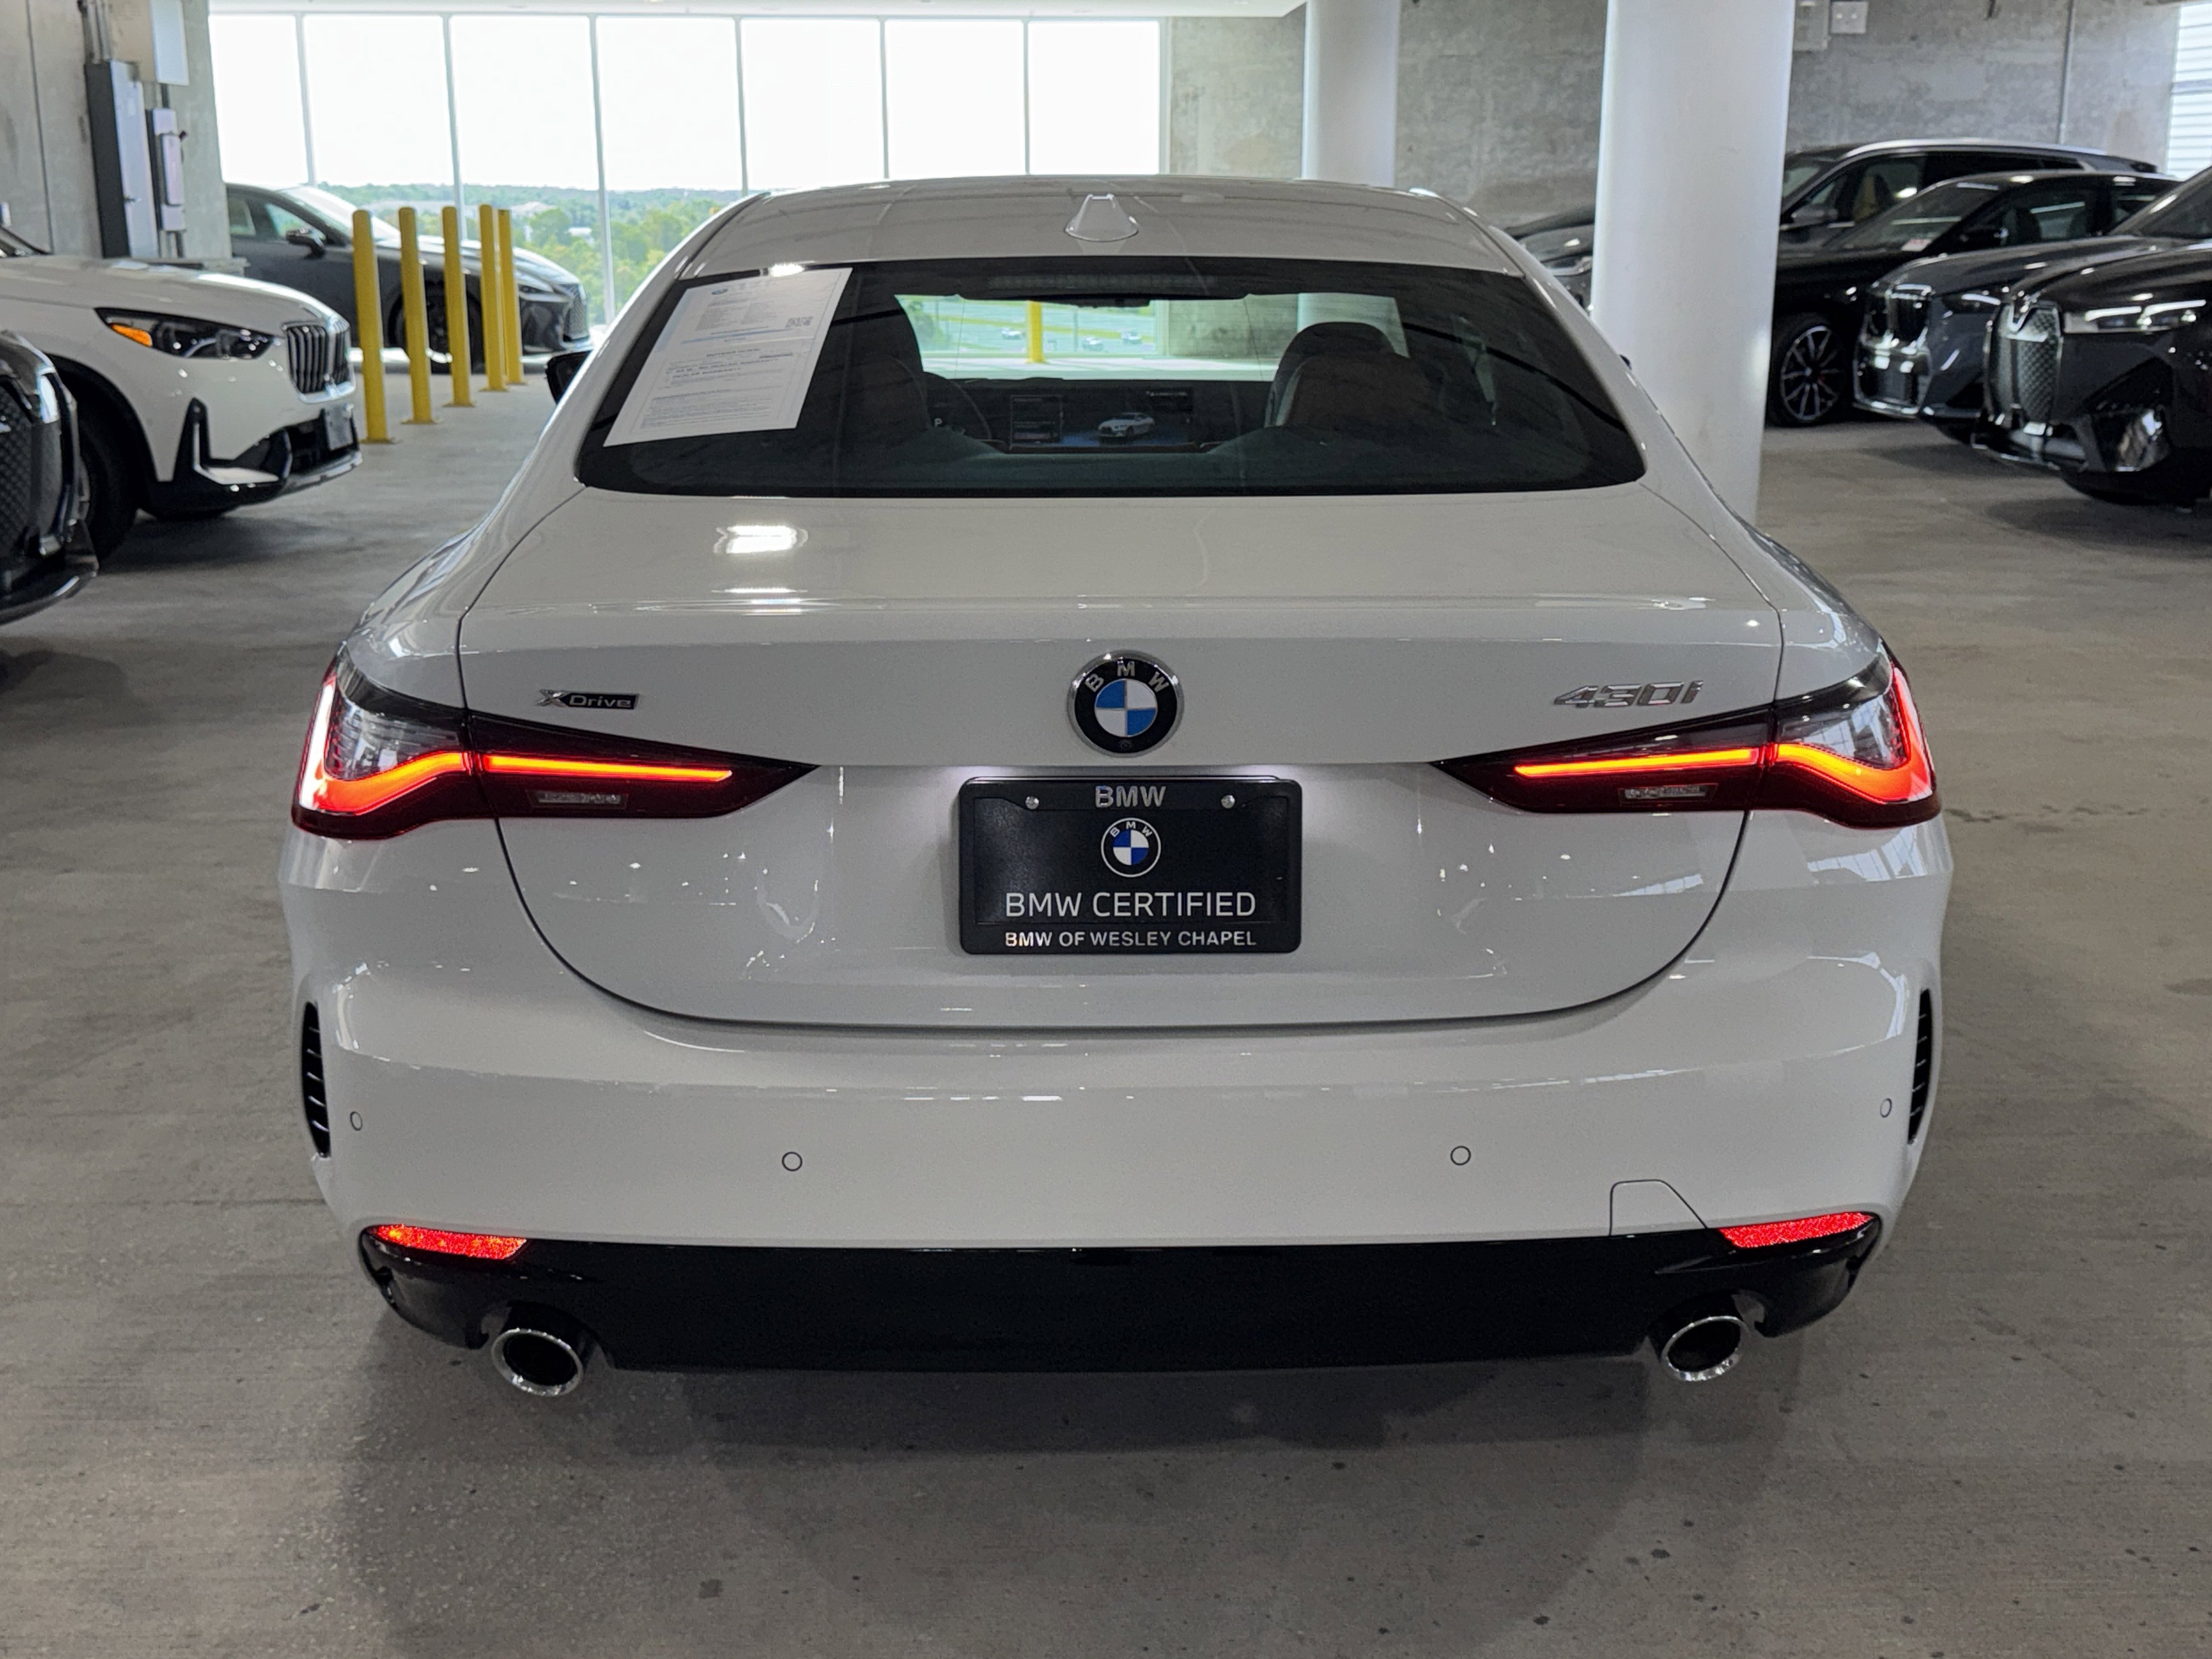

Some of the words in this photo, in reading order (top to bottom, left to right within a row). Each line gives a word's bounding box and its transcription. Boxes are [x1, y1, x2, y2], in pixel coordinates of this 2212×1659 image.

[1084, 660, 1170, 692] BMW
[1554, 679, 1704, 708] 430i
[1095, 786, 1166, 808] BMW
[1109, 821, 1153, 838] BMW
[1006, 892, 1082, 917] BMW
[1092, 892, 1256, 917] CERTIFIED
[1005, 931, 1052, 947] BMW
[1059, 931, 1085, 947] OF
[1090, 931, 1171, 947] WESLEY
[1178, 930, 1257, 947] CHAPEL
